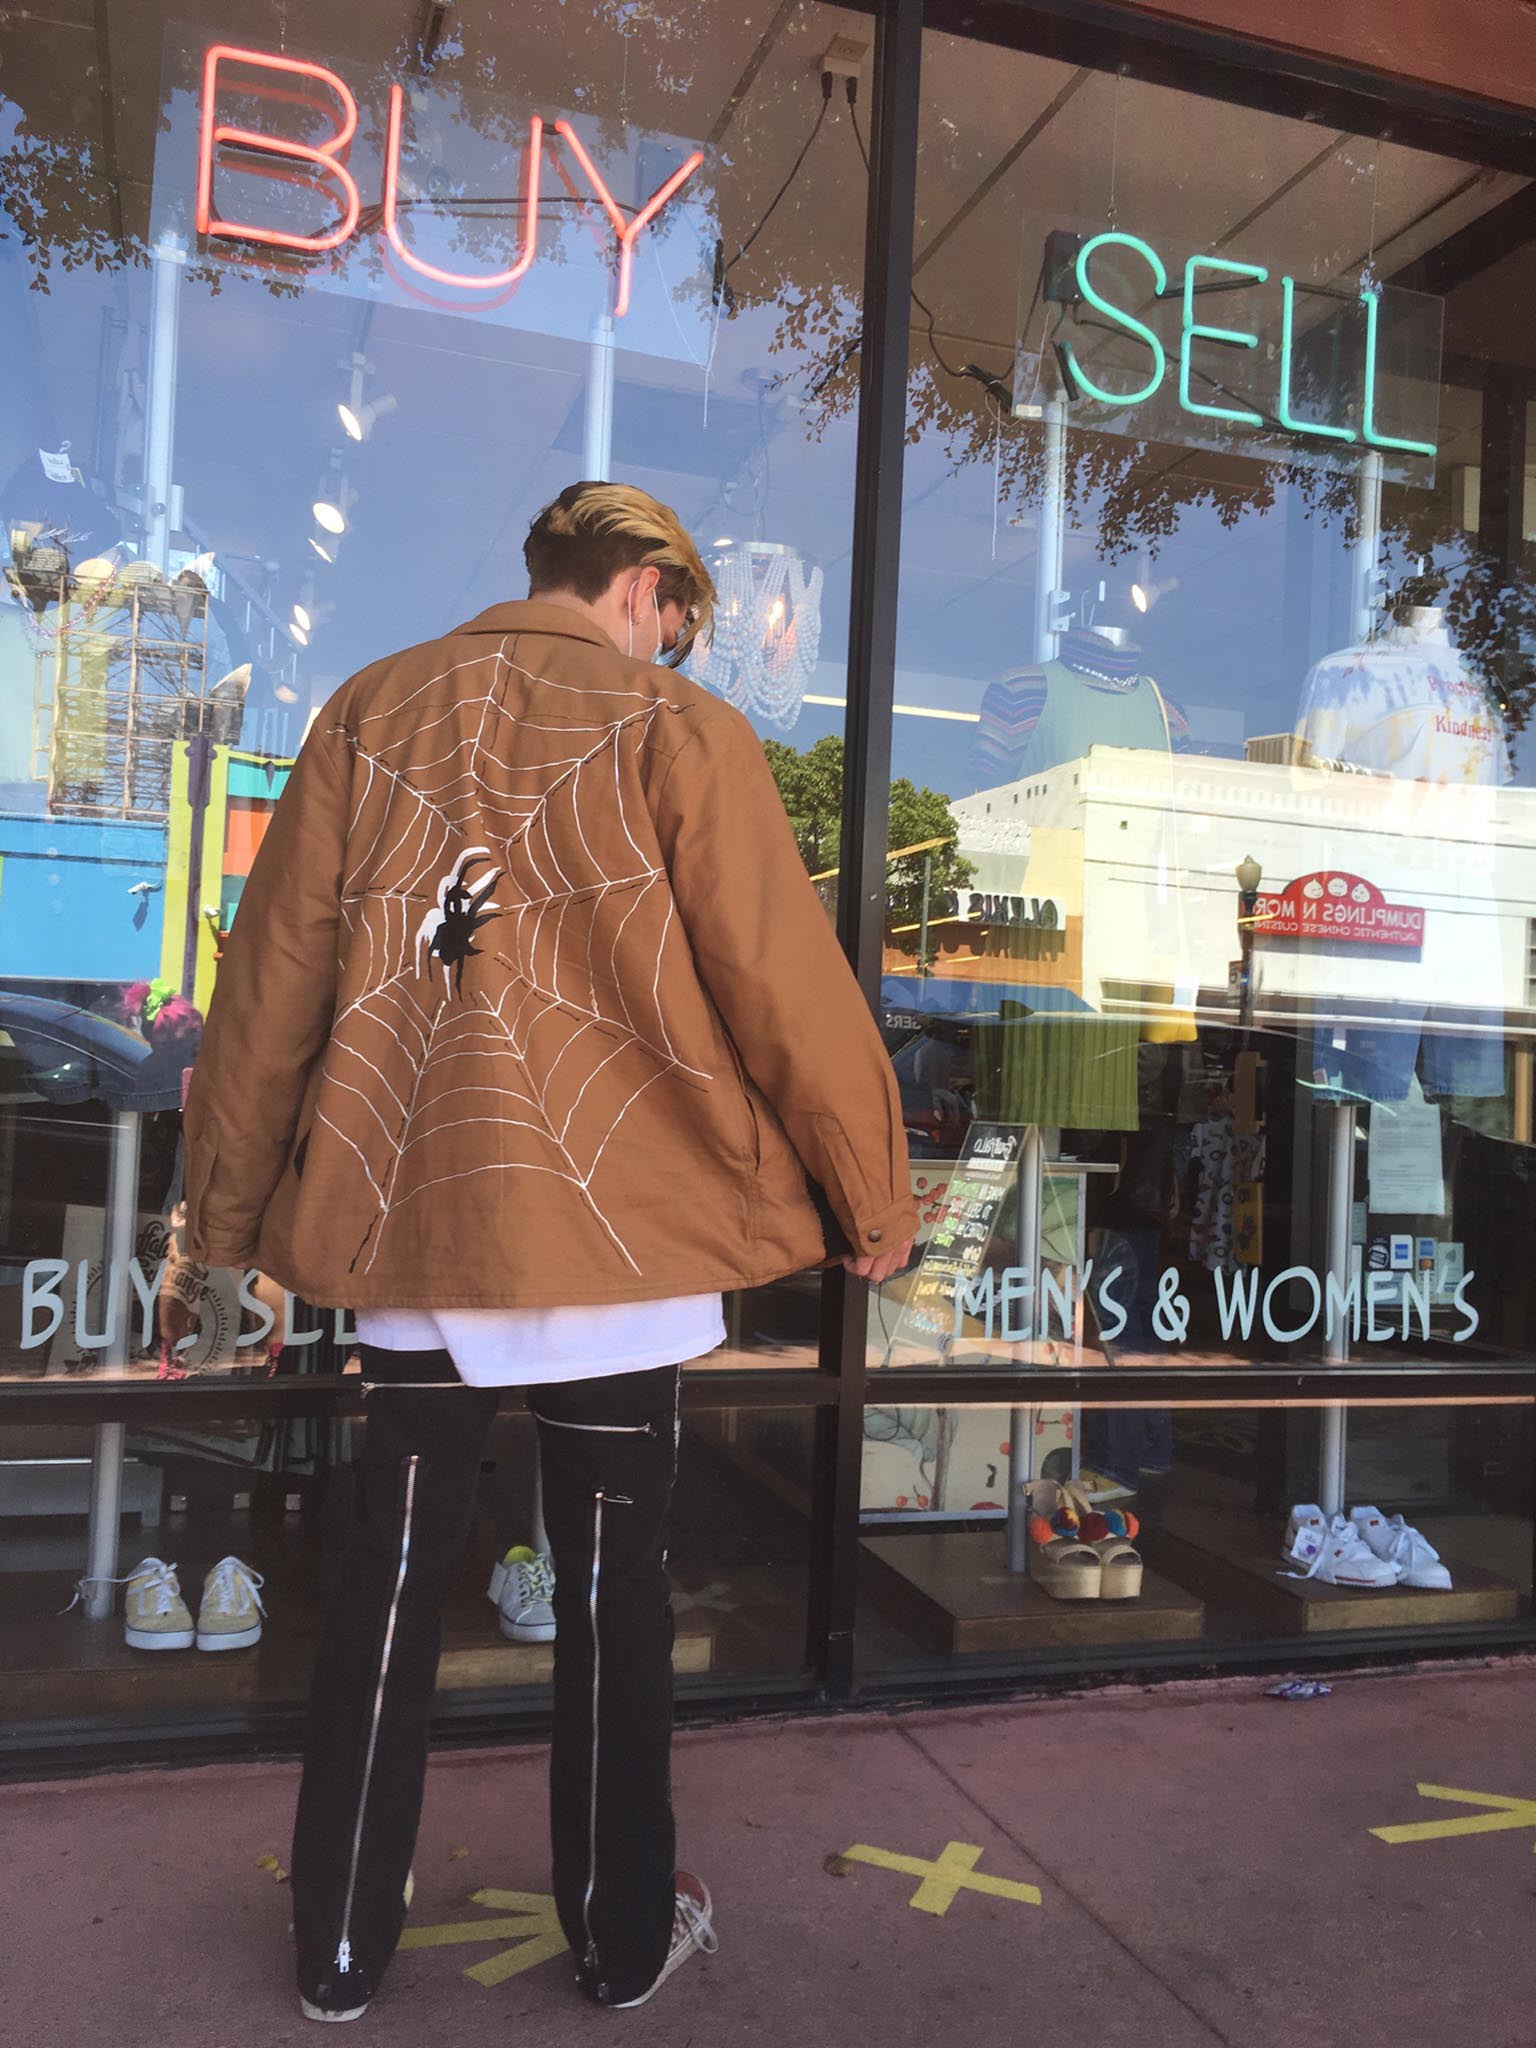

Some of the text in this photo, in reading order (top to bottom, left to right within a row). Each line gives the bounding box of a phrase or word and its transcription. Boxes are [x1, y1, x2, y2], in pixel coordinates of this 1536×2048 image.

[197, 45, 704, 318] BUY
[1060, 231, 1438, 457] SELL
[1435, 714, 1492, 742] Kindness
[954, 1258, 1479, 1344] MEN'S & WOMEN'S
